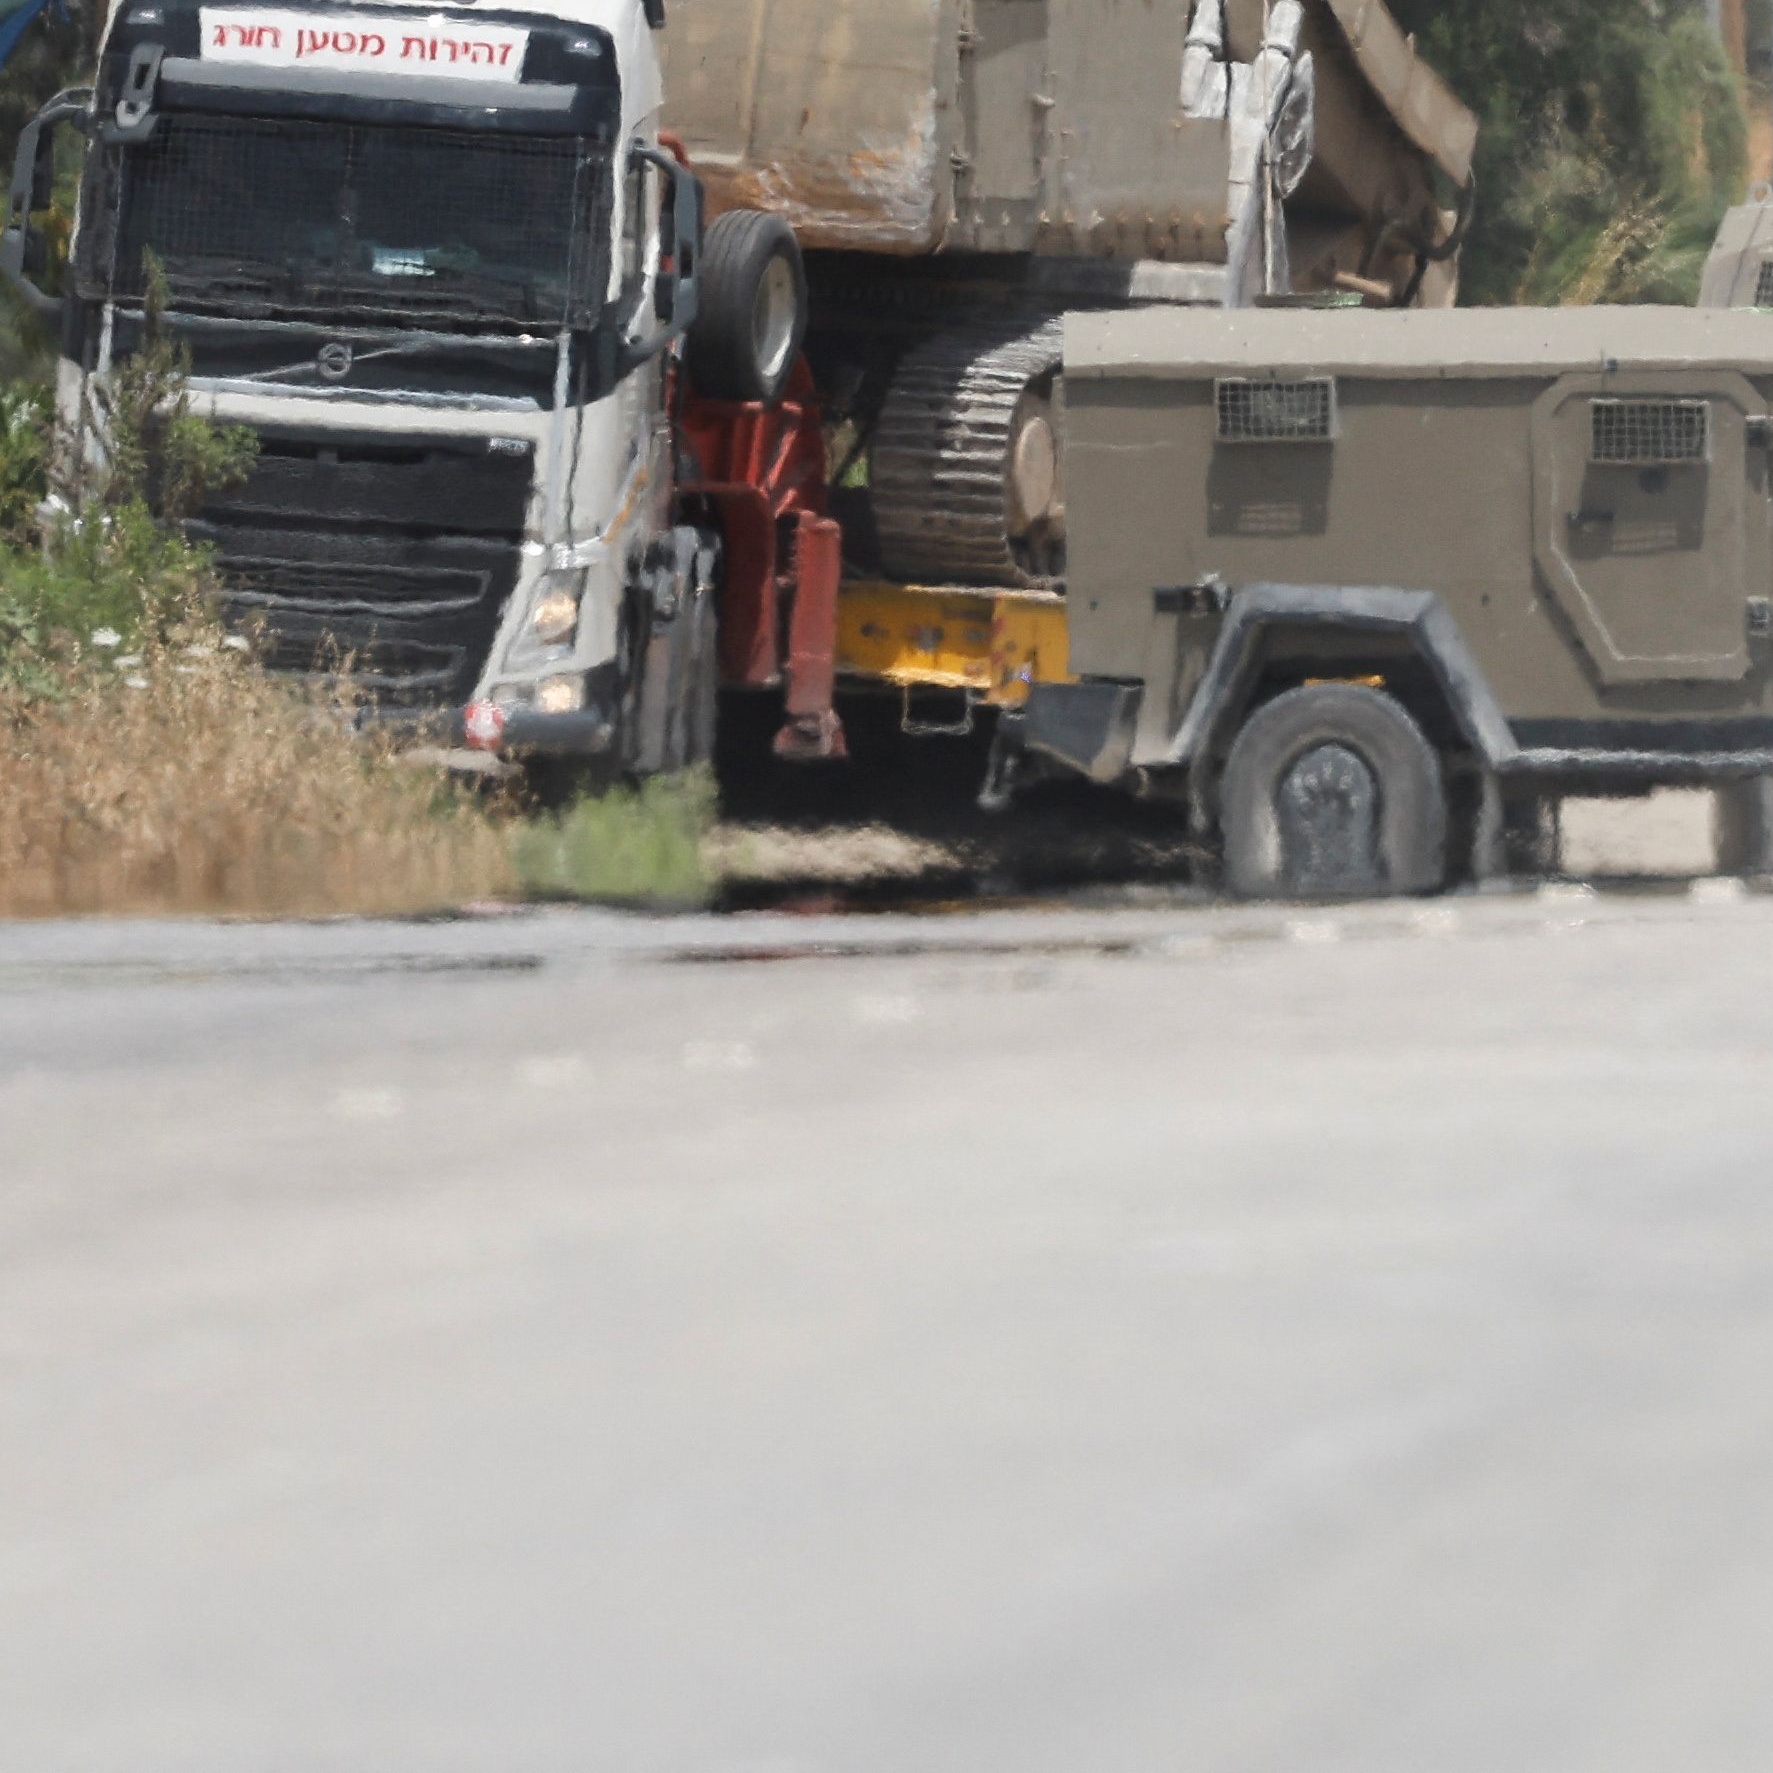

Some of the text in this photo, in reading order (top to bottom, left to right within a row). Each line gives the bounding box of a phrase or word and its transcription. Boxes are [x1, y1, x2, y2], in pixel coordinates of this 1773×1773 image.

[213, 24, 513, 66] זהירות מטען חורג
